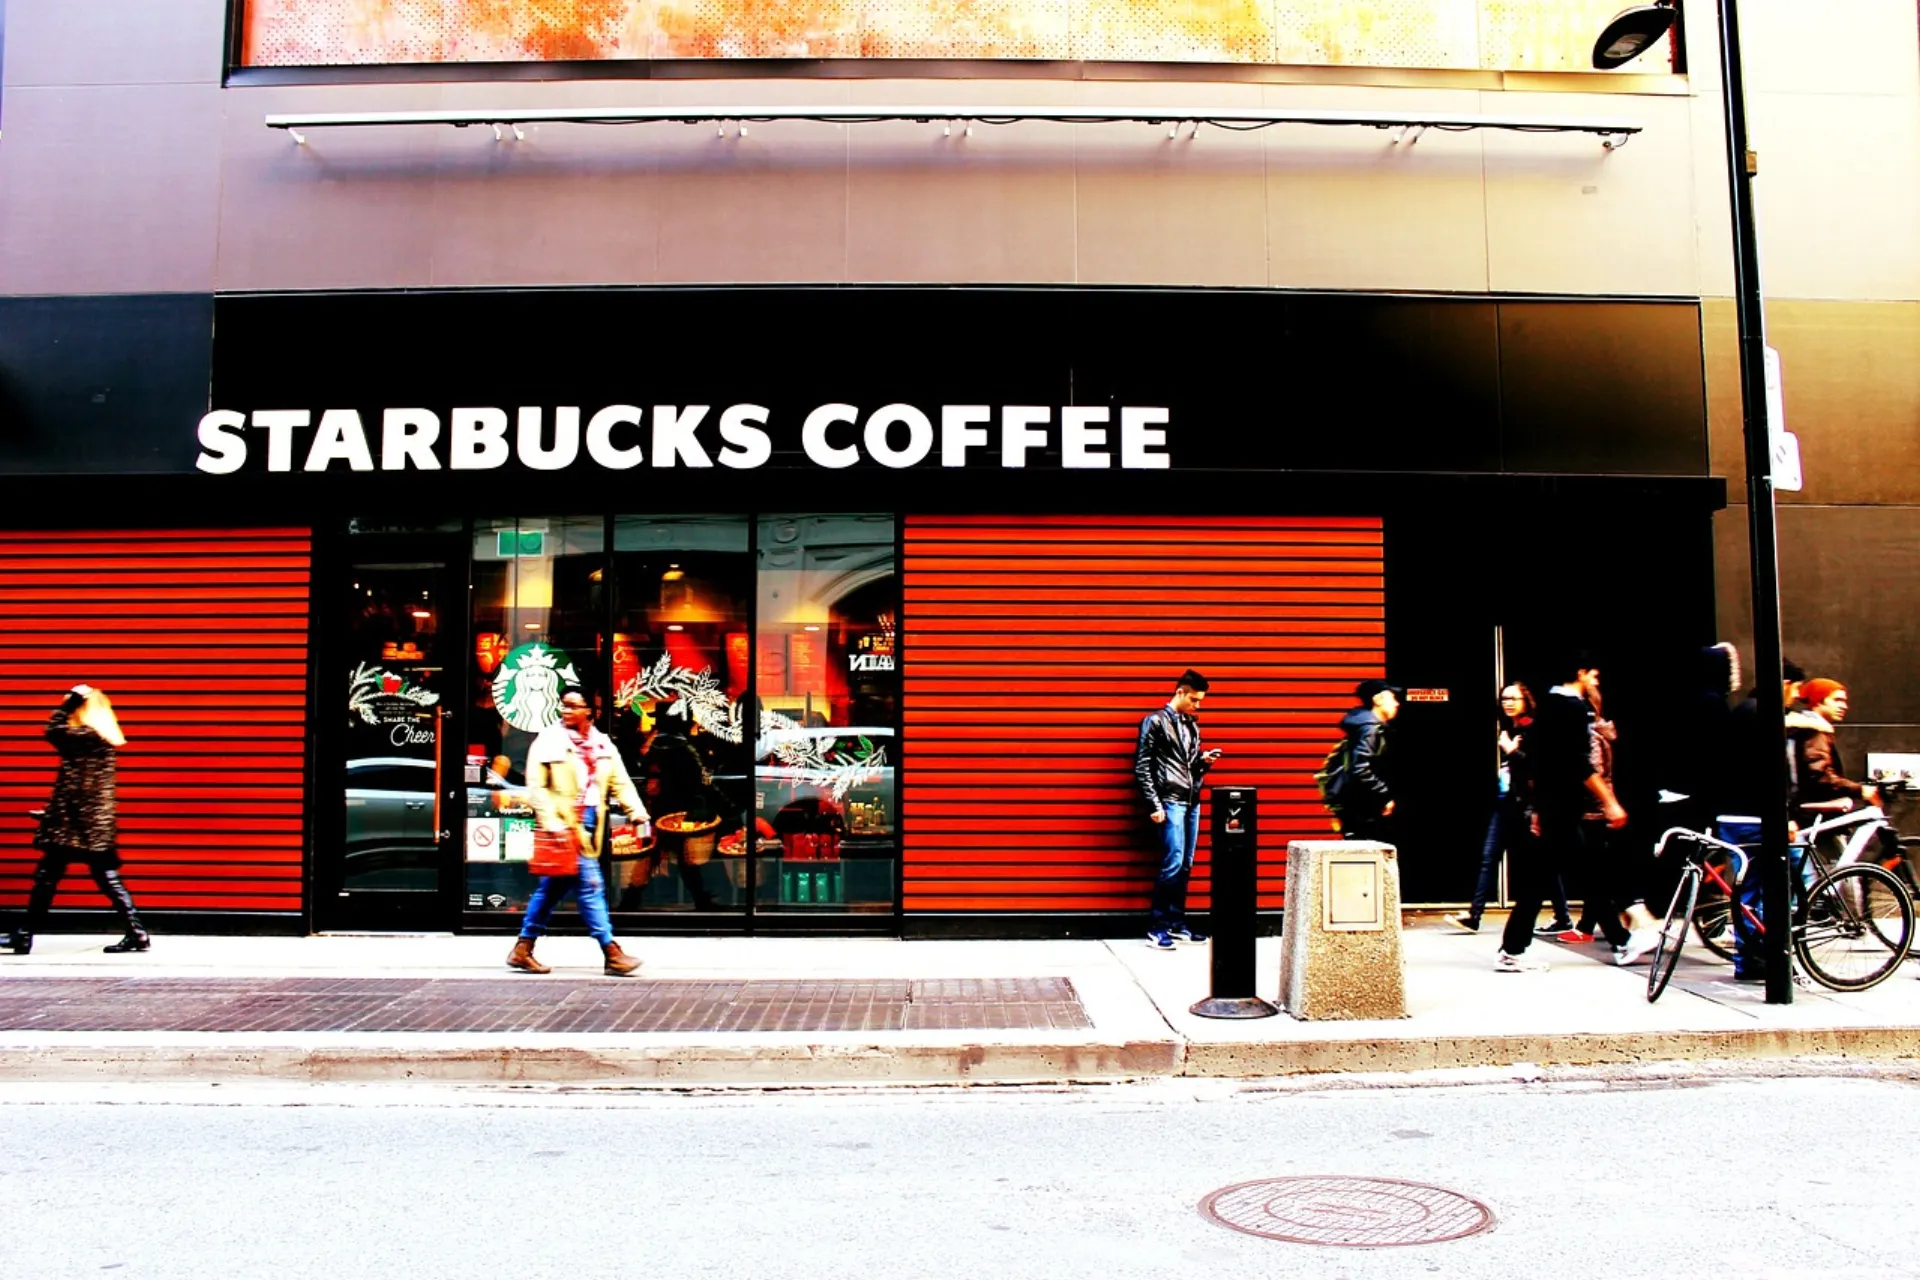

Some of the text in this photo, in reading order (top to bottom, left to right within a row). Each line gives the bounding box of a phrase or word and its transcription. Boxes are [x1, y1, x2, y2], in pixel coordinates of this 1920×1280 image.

[196, 403, 1171, 474] STARBUCKS COFFEE
[390, 722, 436, 746] Cheer
